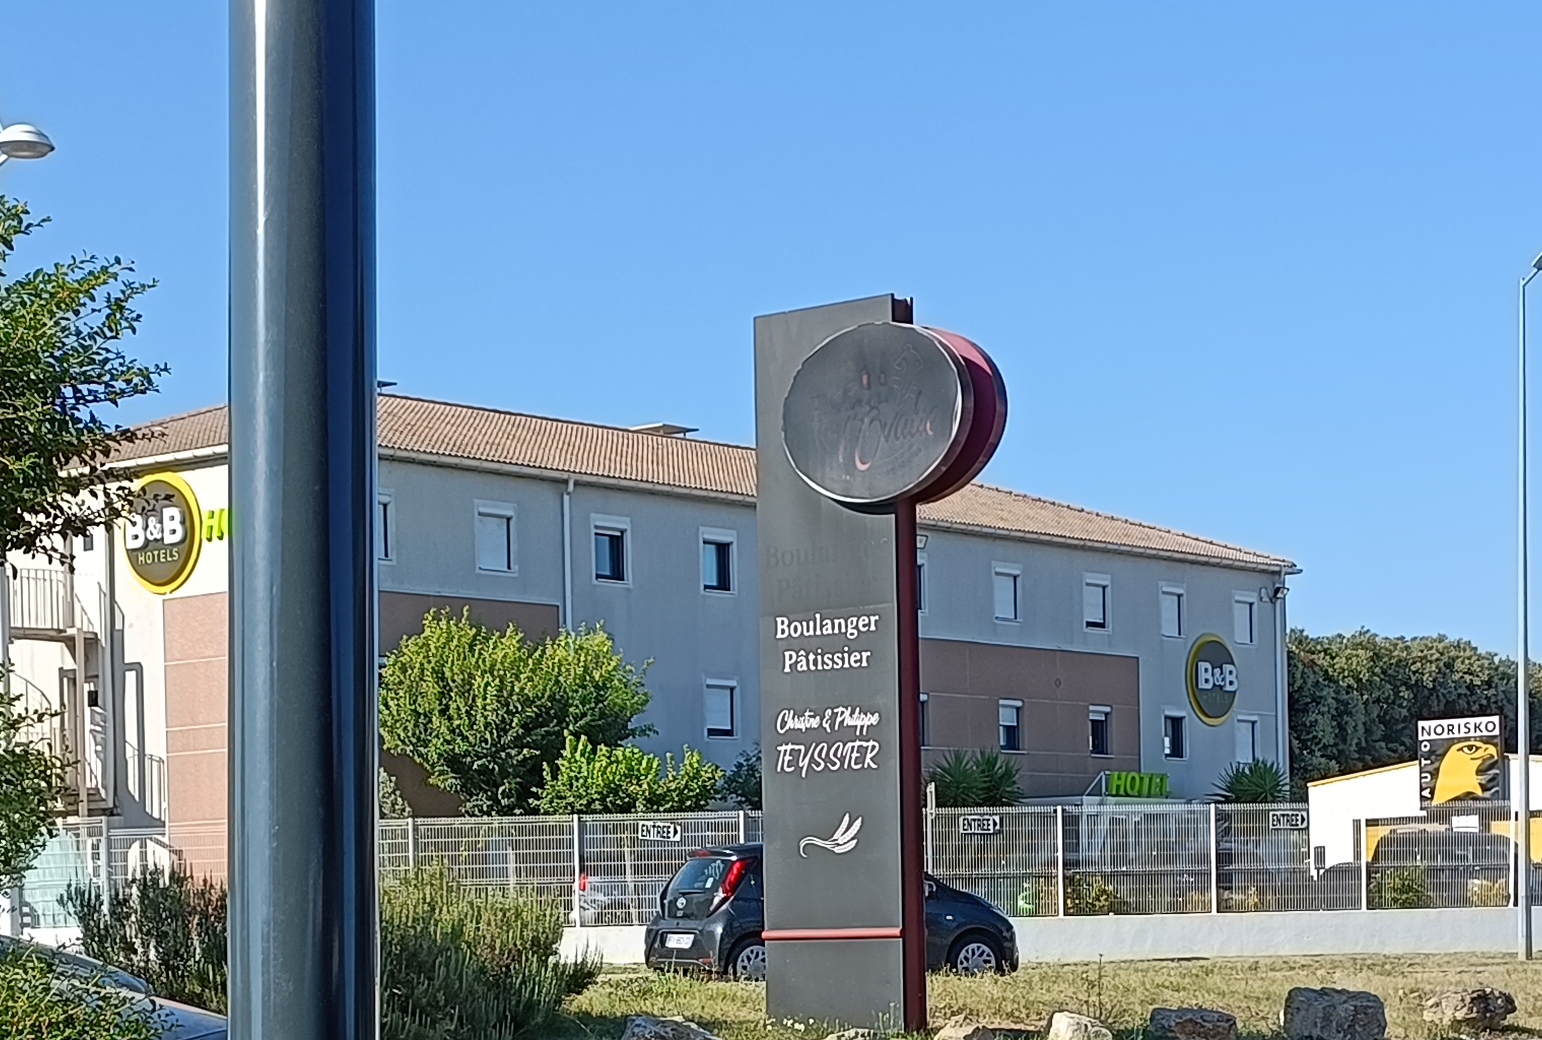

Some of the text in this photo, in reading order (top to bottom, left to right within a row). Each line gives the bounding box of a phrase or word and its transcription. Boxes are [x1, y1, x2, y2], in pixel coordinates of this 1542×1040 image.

[126, 506, 184, 550] B&B
[138, 548, 179, 565] HOTELS
[775, 612, 879, 640] Boulanger
[783, 646, 871, 673] Pâtissier
[1197, 661, 1238, 692] B&B
[1421, 721, 1497, 737] NORISKO
[776, 739, 880, 778] TEYSSIER
[1421, 741, 1432, 798] AUTO
